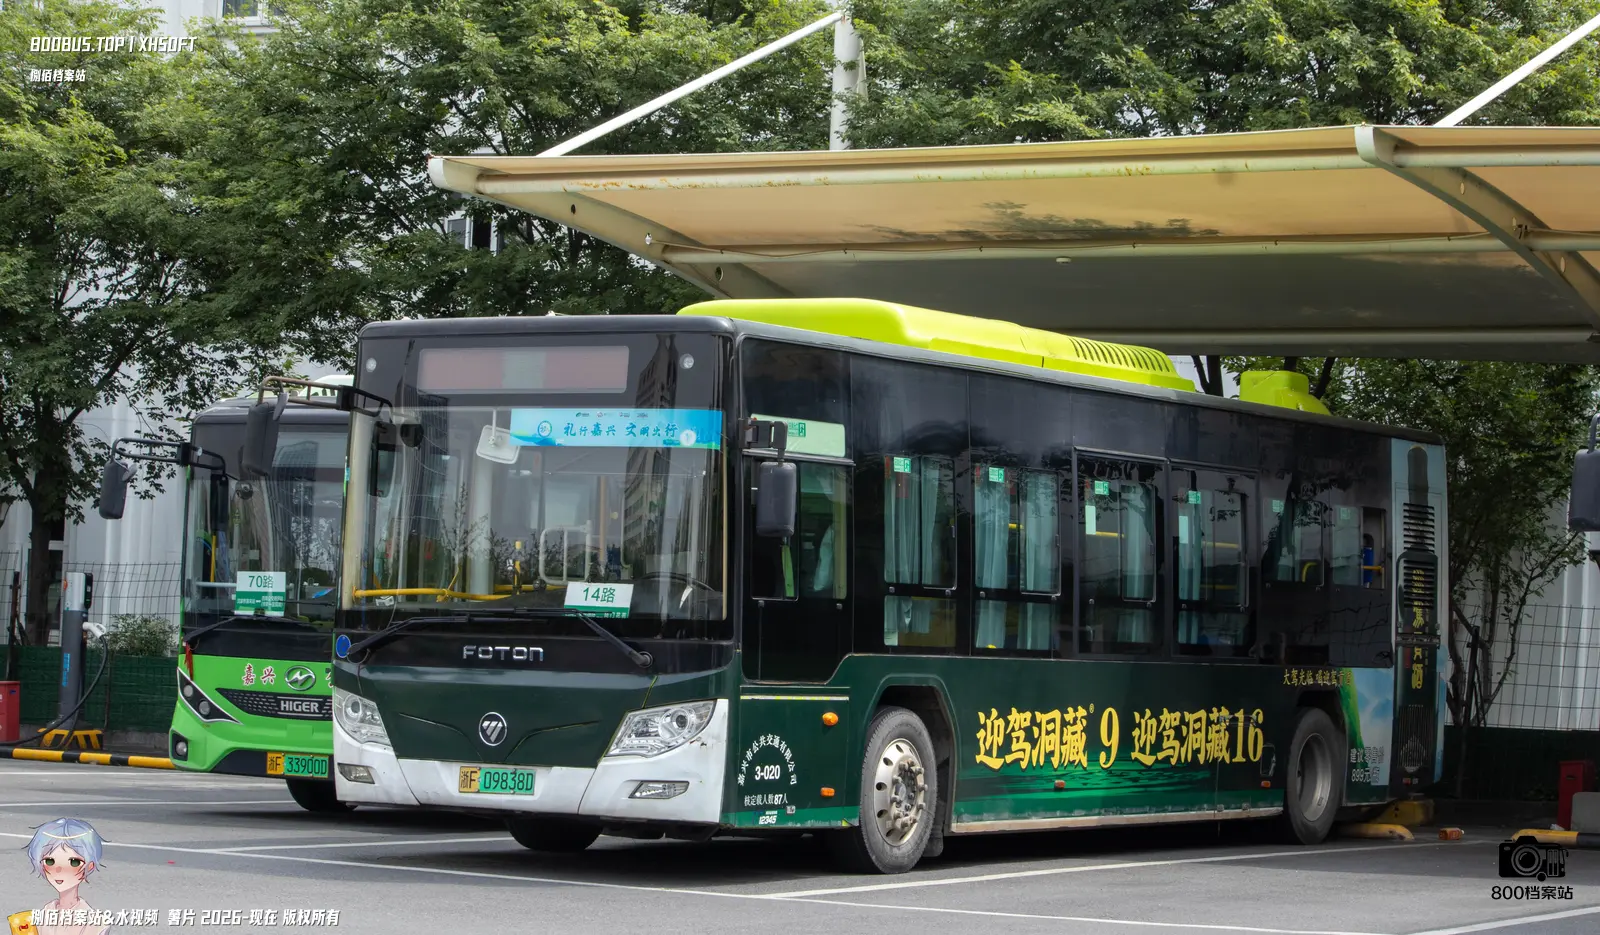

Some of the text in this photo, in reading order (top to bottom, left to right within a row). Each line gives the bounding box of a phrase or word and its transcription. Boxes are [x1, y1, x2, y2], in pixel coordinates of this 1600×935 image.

[563, 422, 679, 438] 礼行嘉兴 文明出行
[248, 575, 274, 588] 70路
[583, 586, 616, 603] 14路
[462, 645, 544, 662] FOTON
[280, 700, 320, 713] HIGER
[755, 765, 781, 780] 3-020
[758, 815, 777, 825] 12345
